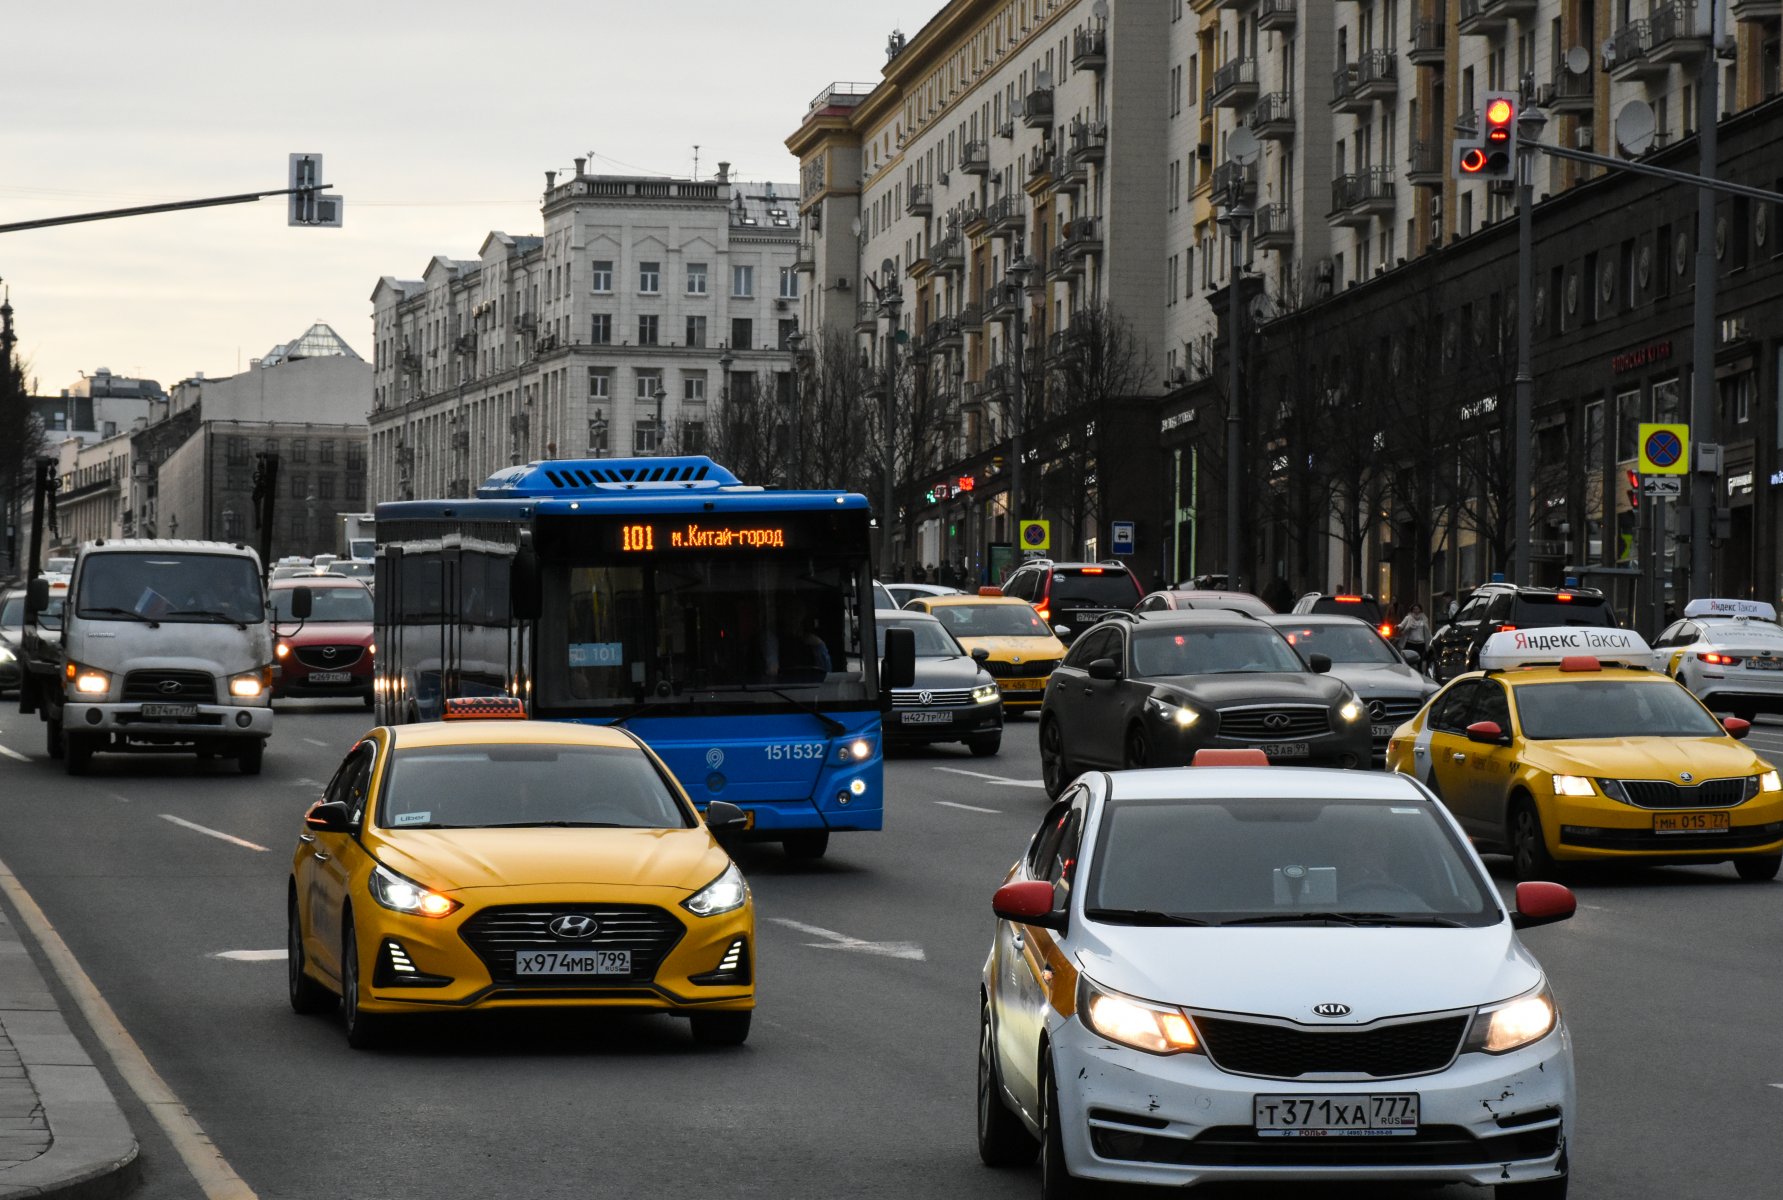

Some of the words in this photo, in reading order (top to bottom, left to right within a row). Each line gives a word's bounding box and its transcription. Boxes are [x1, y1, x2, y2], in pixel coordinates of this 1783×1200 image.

[623, 525, 653, 551] 101
[671, 524, 784, 548] м.Китай-город
[1711, 601, 1736, 612] Яндекс
[1738, 602, 1758, 613] Такси
[1514, 632, 1580, 650] Яндекс
[1580, 630, 1631, 648] Такси
[592, 647, 616, 661] 101
[764, 744, 824, 760] 151532
[1660, 818, 1676, 829] МН
[1681, 815, 1706, 828] 015
[522, 953, 595, 972] Х974МВ
[598, 952, 626, 967] 799
[1318, 1004, 1347, 1013] KIA
[1264, 1099, 1367, 1126] Т371ХА
[1372, 1097, 1411, 1118] 777
[1380, 1117, 1400, 1125] RUS
